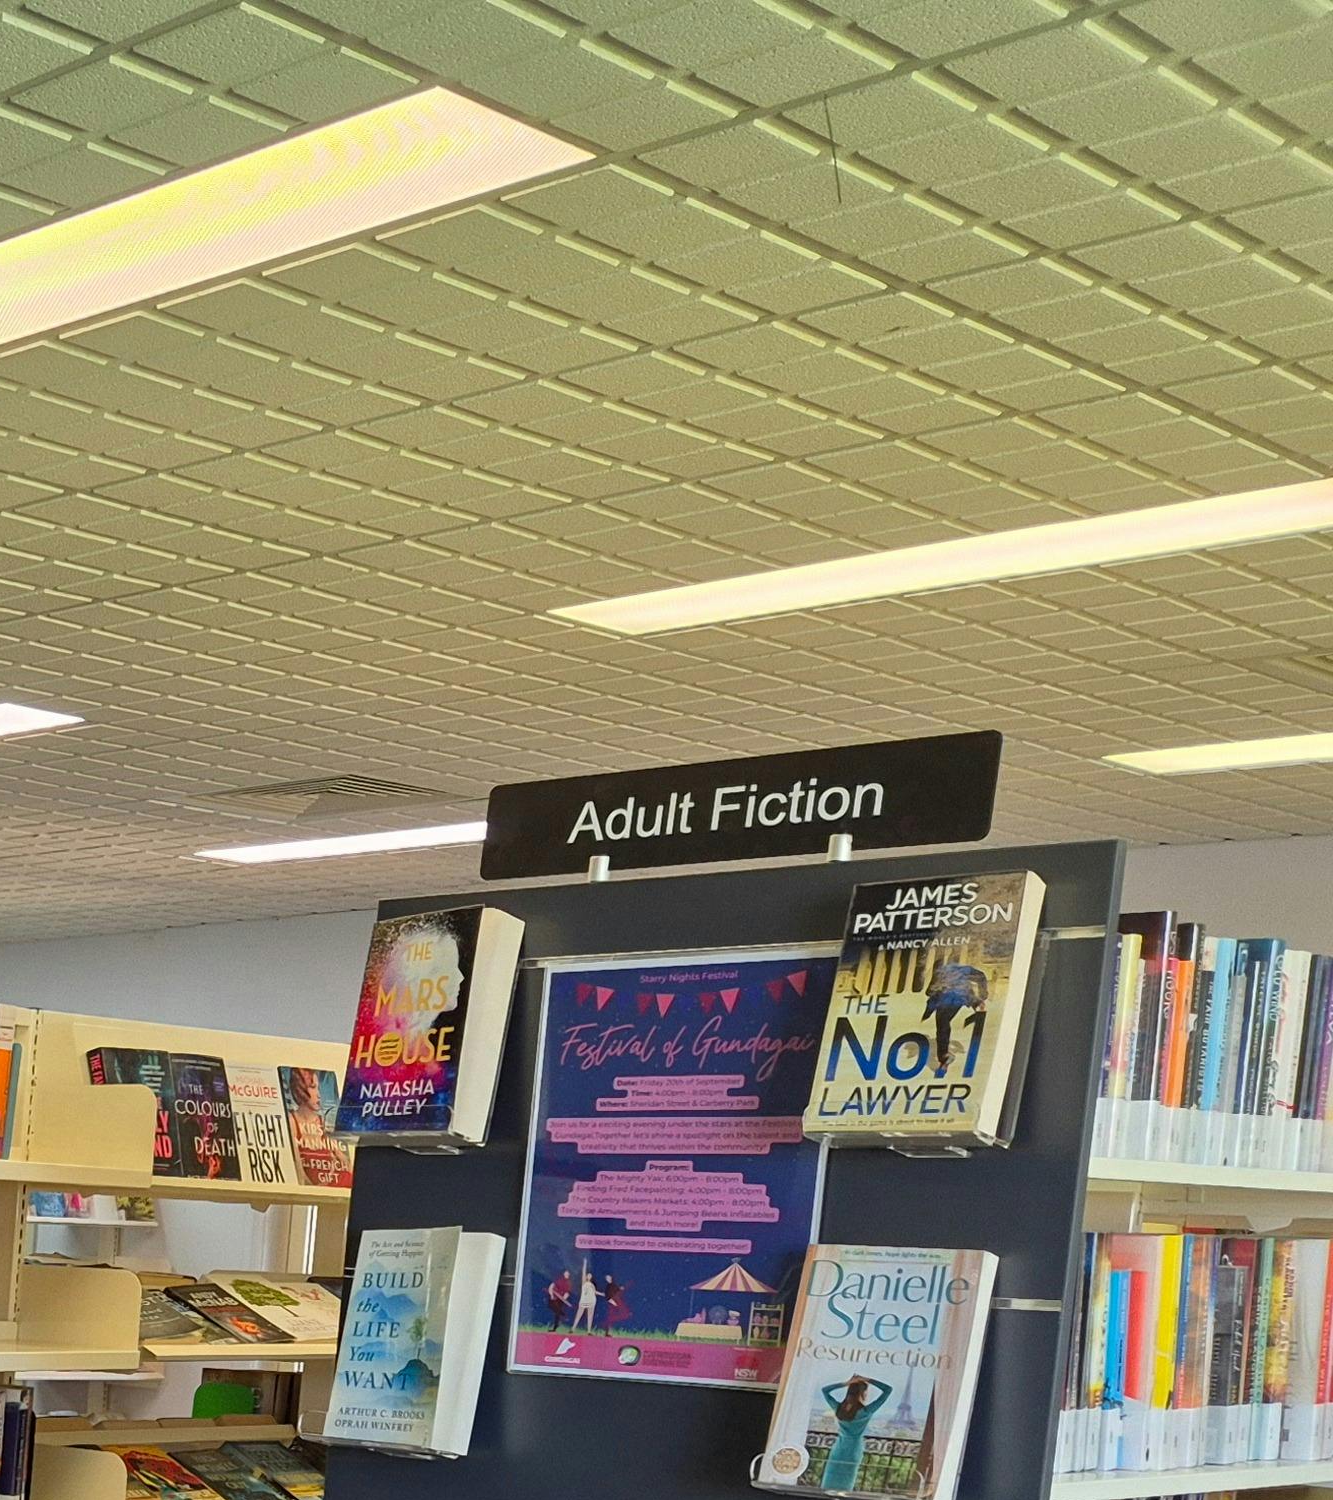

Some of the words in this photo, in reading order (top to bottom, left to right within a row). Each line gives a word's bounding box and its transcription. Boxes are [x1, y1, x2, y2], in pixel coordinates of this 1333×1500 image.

[566, 793, 694, 844] Adult
[709, 778, 885, 831] Fiction
[885, 882, 979, 911] JAMES
[852, 902, 1014, 935] PATTERSON
[404, 941, 433, 962] THE
[886, 937, 929, 951] NANCY
[931, 935, 971, 947] ALLEN
[639, 975, 667, 984] Starry
[669, 972, 700, 983] Nights
[701, 970, 739, 981] Festival
[373, 975, 449, 1017] MARS
[843, 993, 890, 1015] THE
[354, 1026, 455, 1069] HOUSE
[560, 1022, 657, 1071] Festival
[662, 1025, 688, 1068] of
[692, 1014, 817, 1082] Gundagai
[188, 1083, 204, 1097] THE
[228, 1083, 278, 1100] McGUIRE
[359, 1079, 435, 1100] NATASHA
[639, 1078, 663, 1088] Friday
[696, 1077, 742, 1088] September
[174, 1099, 231, 1119] COLOURS
[361, 1098, 428, 1118] PULLEY
[599, 1099, 628, 1108] Where:
[665, 1099, 691, 1108] Street
[818, 1083, 972, 1117] LAWYER
[206, 1120, 219, 1133] OF
[235, 1110, 283, 1150] FLIGHT
[194, 1136, 234, 1157] DEATH
[295, 1135, 347, 1152] MANNING
[250, 1146, 286, 1185] RISK
[310, 1158, 349, 1172] FRENCH
[649, 1163, 690, 1173] Program:
[317, 1172, 341, 1184] GIFT
[362, 1271, 424, 1289] BUILD
[805, 1258, 970, 1306] Danielle
[356, 1297, 378, 1313] the
[820, 1291, 941, 1346] Steel
[352, 1320, 401, 1339] LIFE
[349, 1345, 375, 1362] You
[795, 1336, 954, 1371] Resurrection
[343, 1369, 410, 1391] WANT
[734, 1367, 758, 1378] NSW
[337, 1406, 378, 1418] ARTHUR
[391, 1410, 426, 1421] BROOKS
[334, 1418, 369, 1430] OPRAH
[371, 1421, 415, 1433] WINFREY
